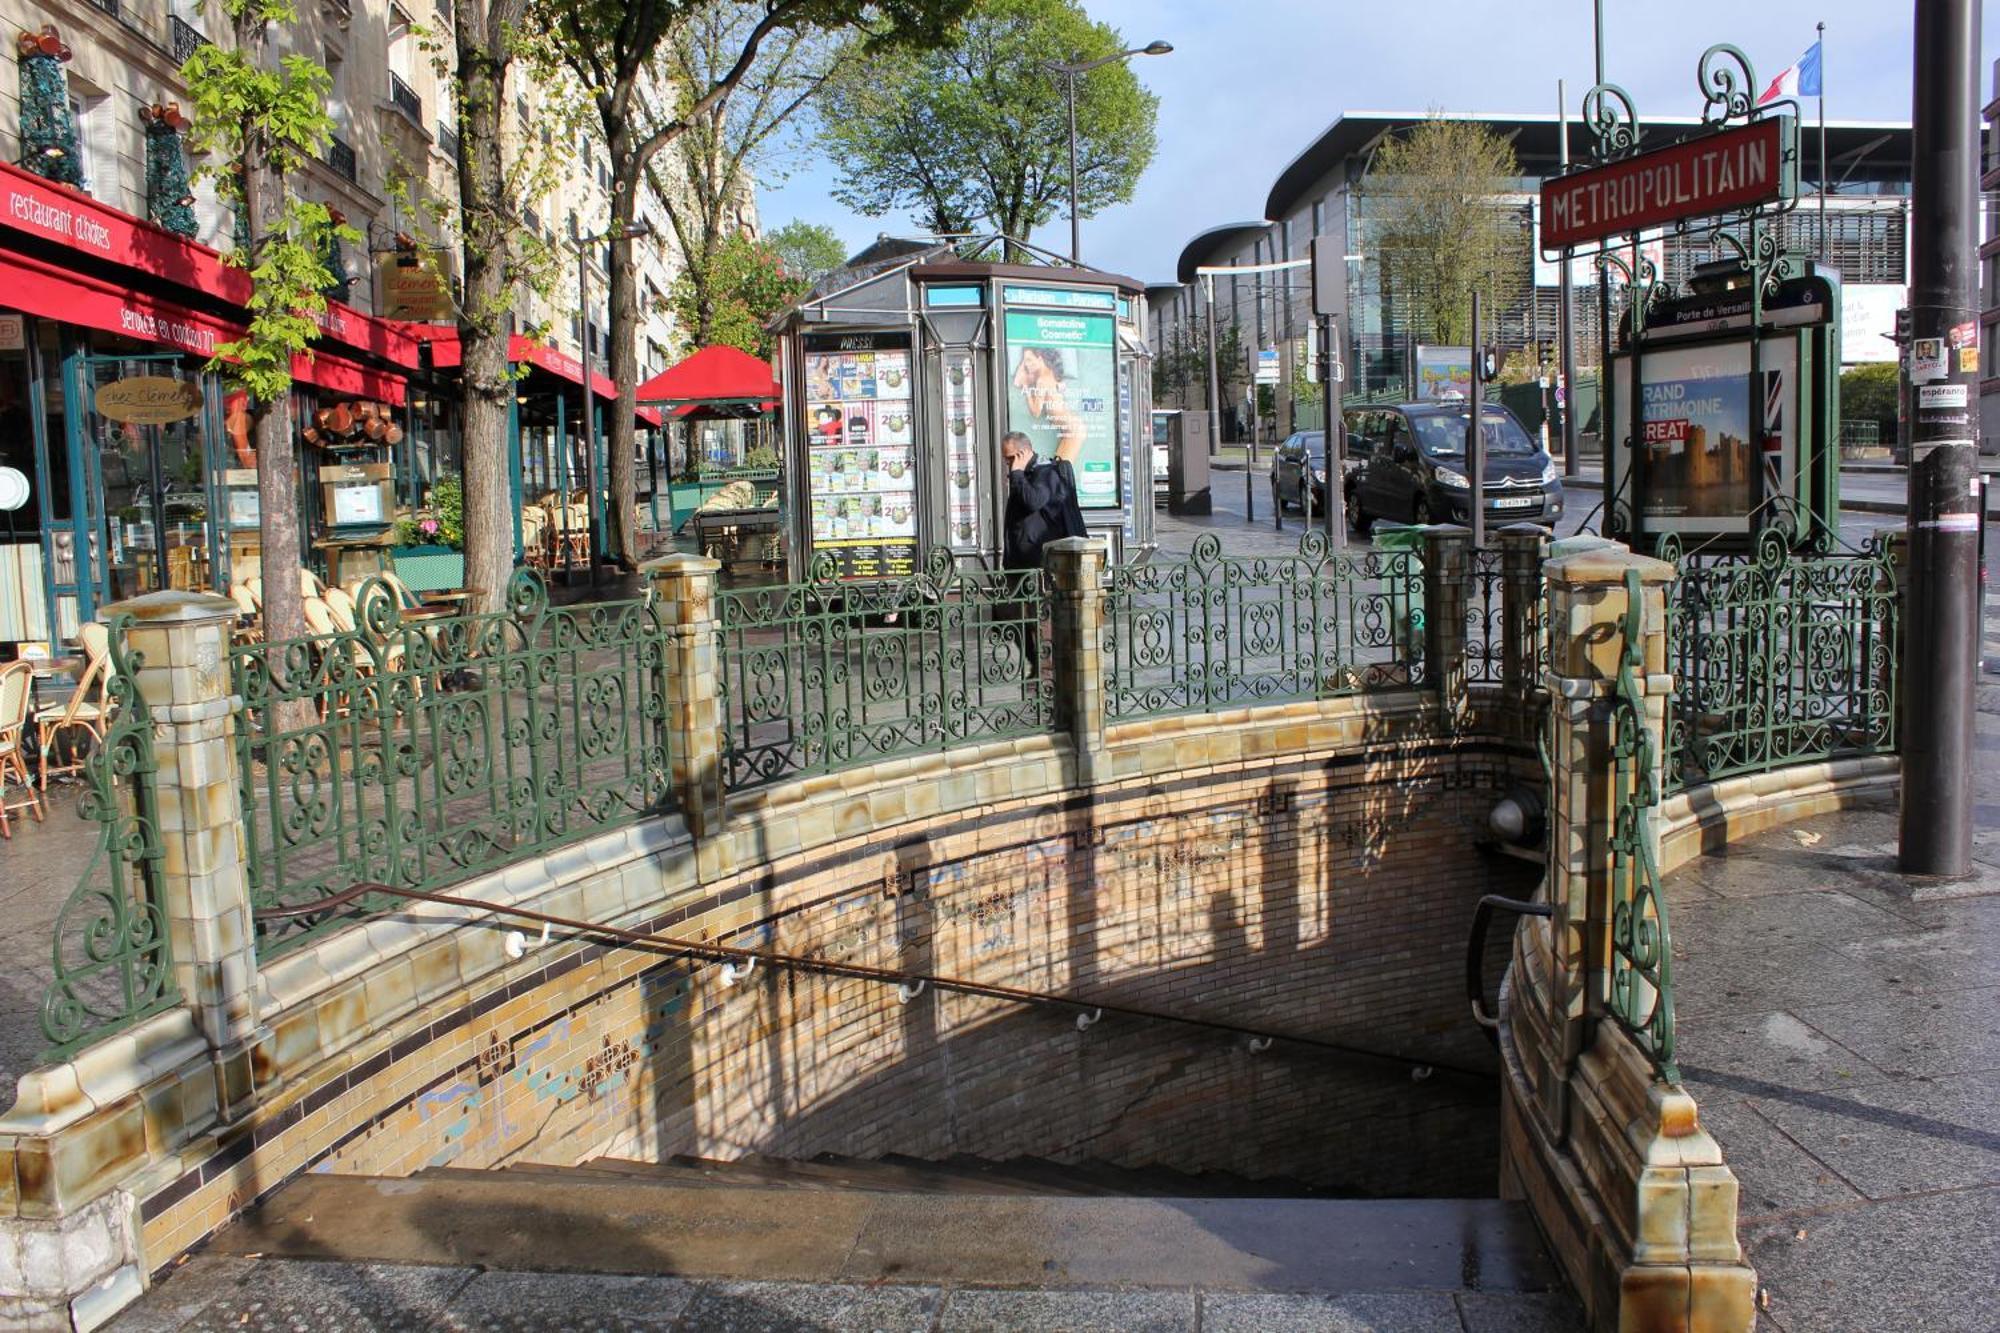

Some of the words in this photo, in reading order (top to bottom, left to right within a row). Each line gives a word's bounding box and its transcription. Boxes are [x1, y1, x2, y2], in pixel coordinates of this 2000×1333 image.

[1552, 139, 1767, 233] METROPOLITAIN
[9, 191, 73, 236] restaurant
[1676, 309, 1701, 322] Porte
[1703, 307, 1715, 318] de
[1716, 300, 1751, 316] Versaill
[120, 307, 157, 336] service
[158, 319, 171, 340] en
[1037, 317, 1086, 329] Somatoline
[840, 335, 875, 350] PRESSE
[1041, 328, 1083, 340] Cosmetic
[1643, 383, 1685, 402] RAND
[1921, 386, 1966, 398] espéranto
[1082, 399, 1104, 412] nuit
[1642, 420, 1687, 440] REAT
